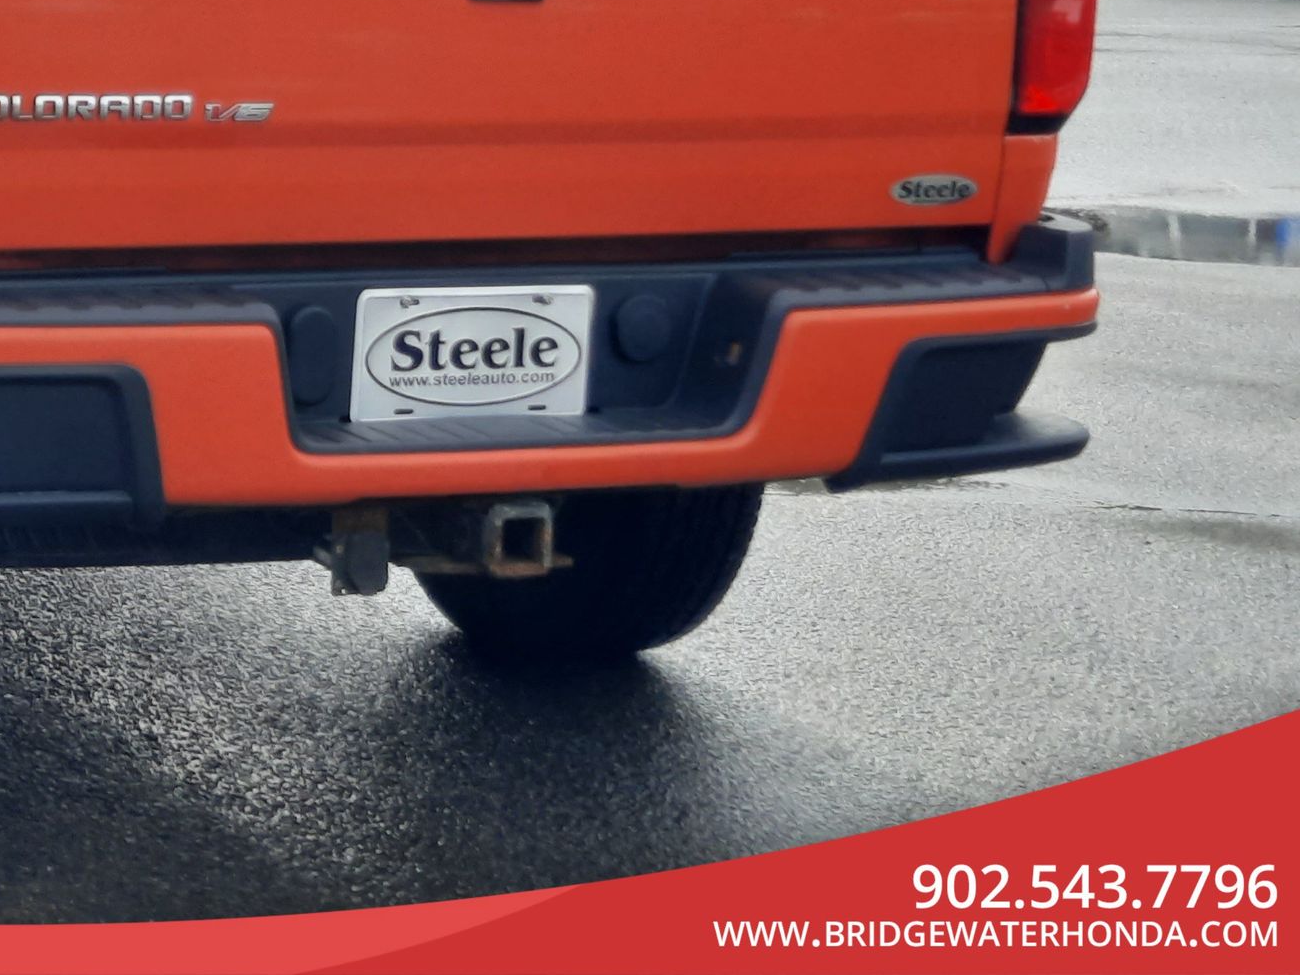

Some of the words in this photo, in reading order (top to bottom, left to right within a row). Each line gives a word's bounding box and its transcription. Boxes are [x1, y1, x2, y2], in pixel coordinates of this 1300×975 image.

[204, 103, 274, 122] V6
[899, 179, 971, 199] Steele
[390, 327, 558, 372] Steele
[389, 370, 555, 388] www.steeleauto.com
